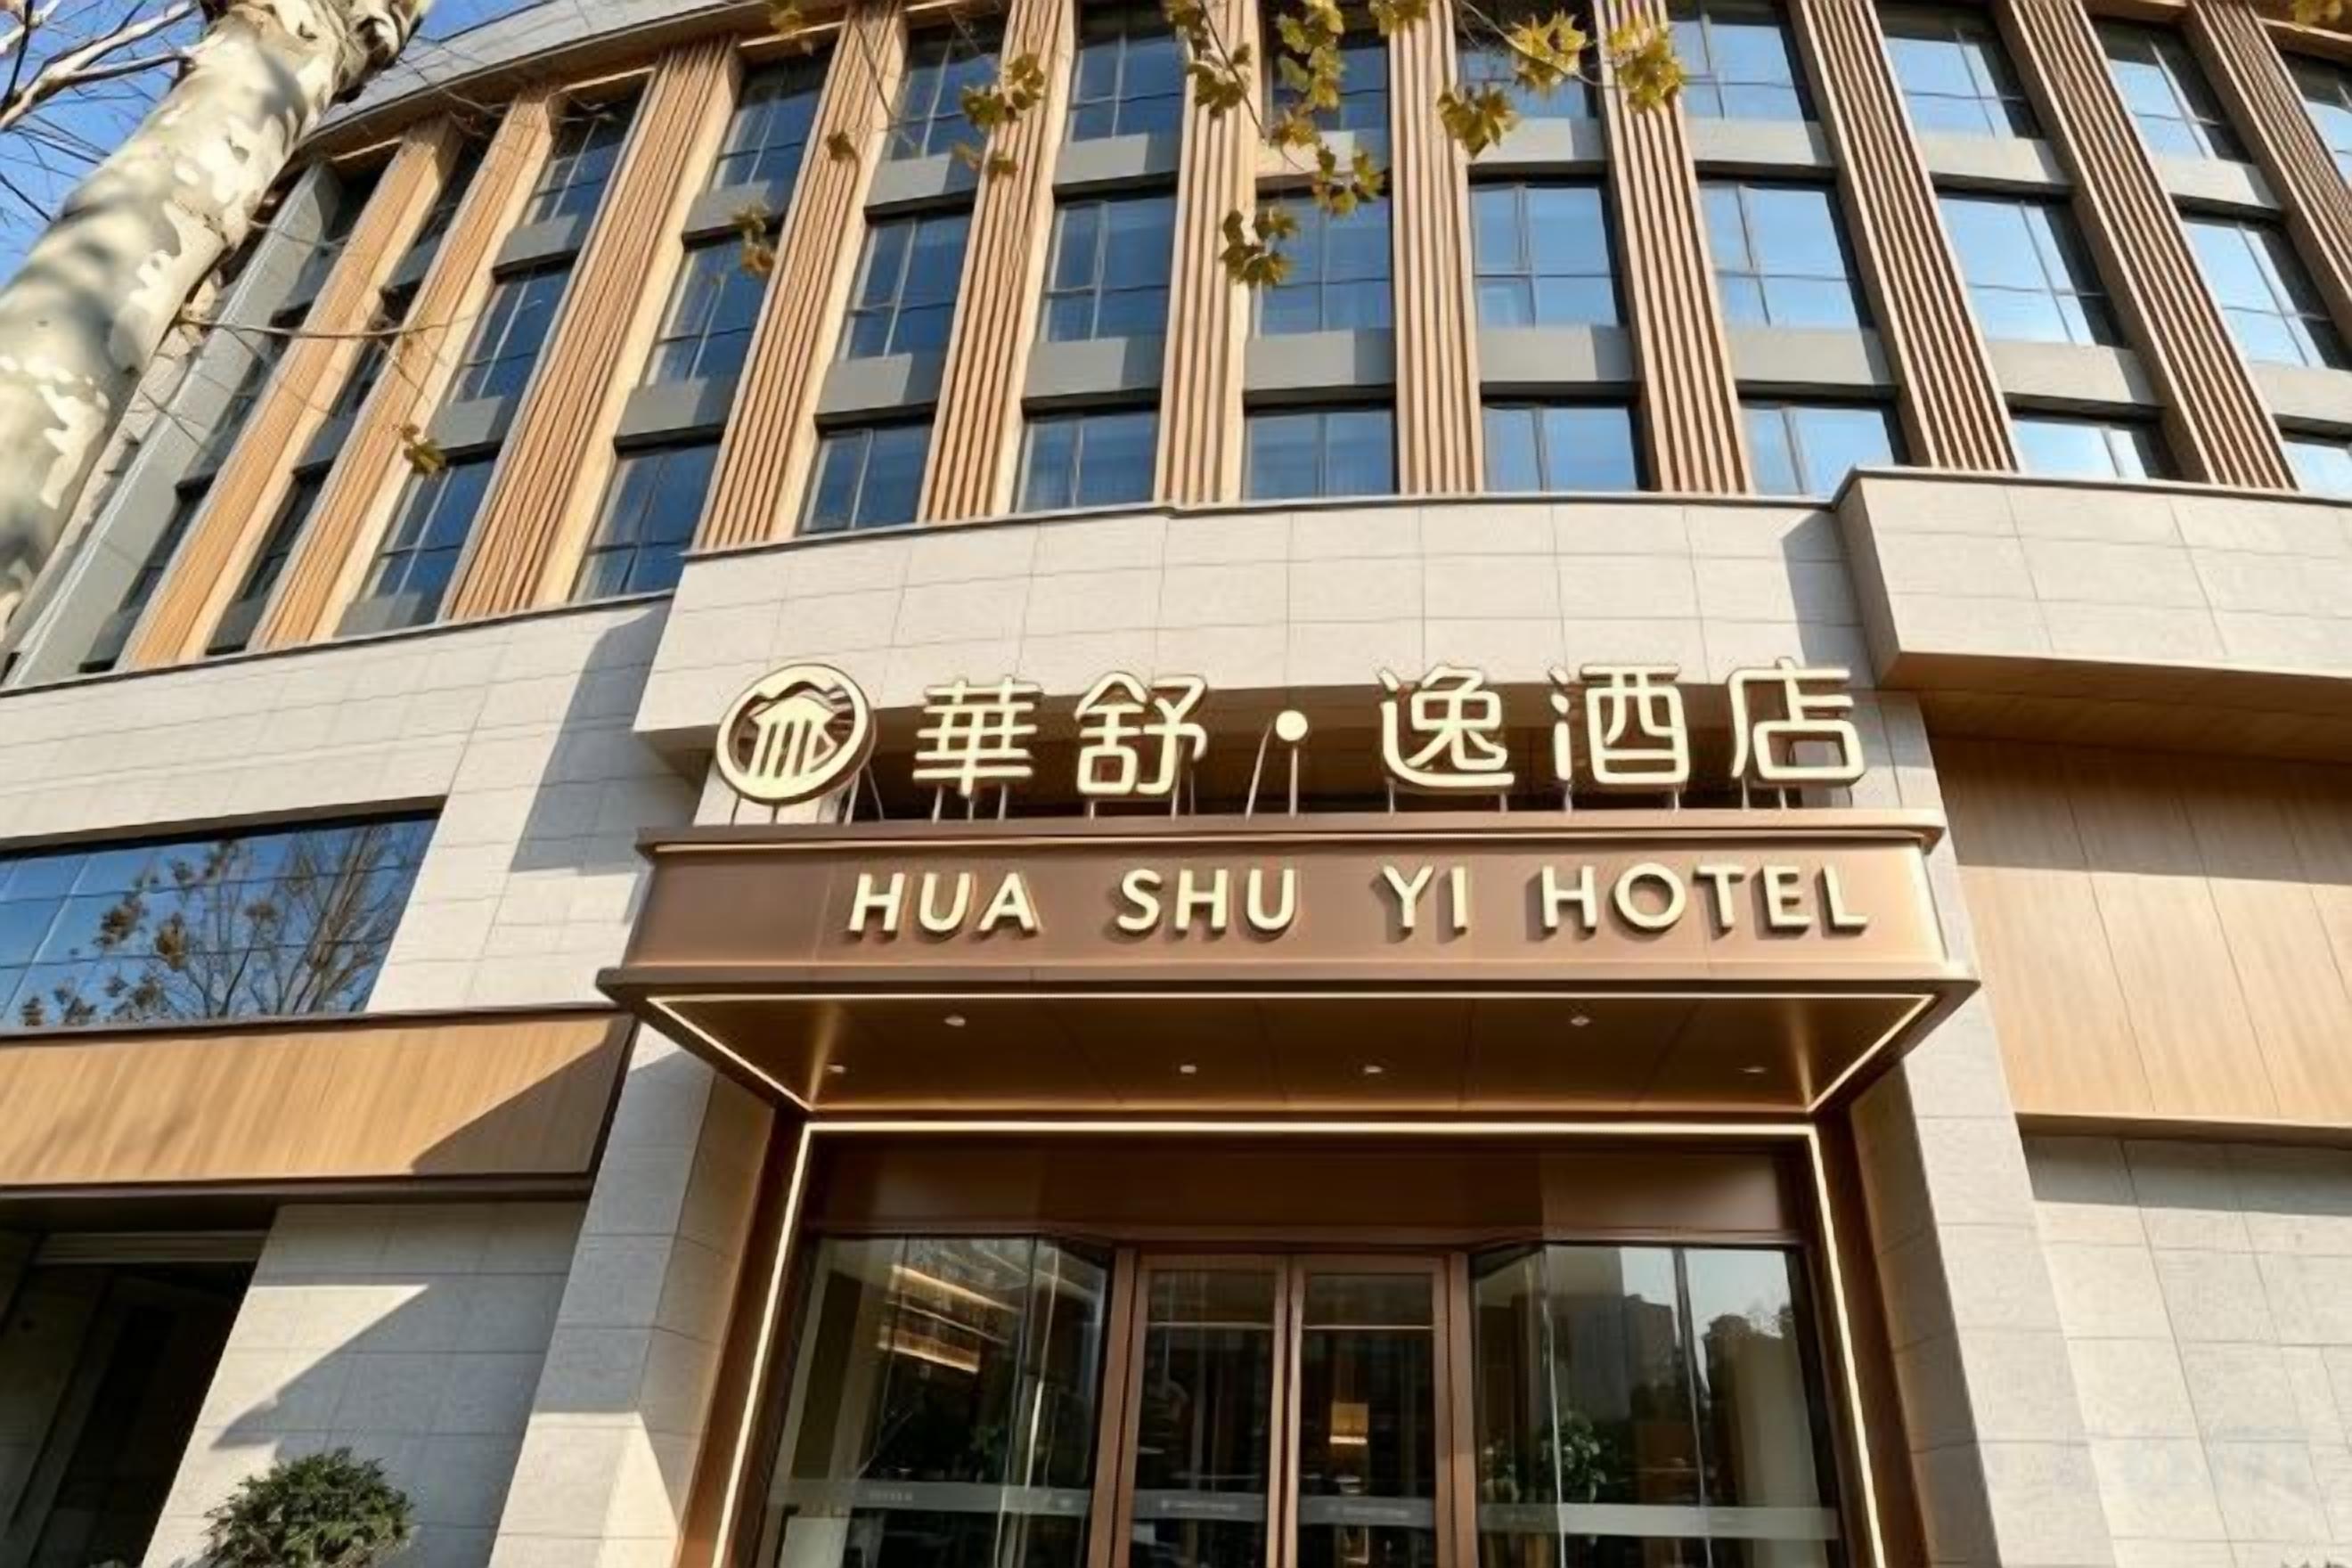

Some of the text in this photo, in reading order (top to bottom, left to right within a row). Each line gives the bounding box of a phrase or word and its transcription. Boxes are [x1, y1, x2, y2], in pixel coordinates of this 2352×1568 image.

[847, 862, 1868, 934] HUA SHU YI HOTEL
